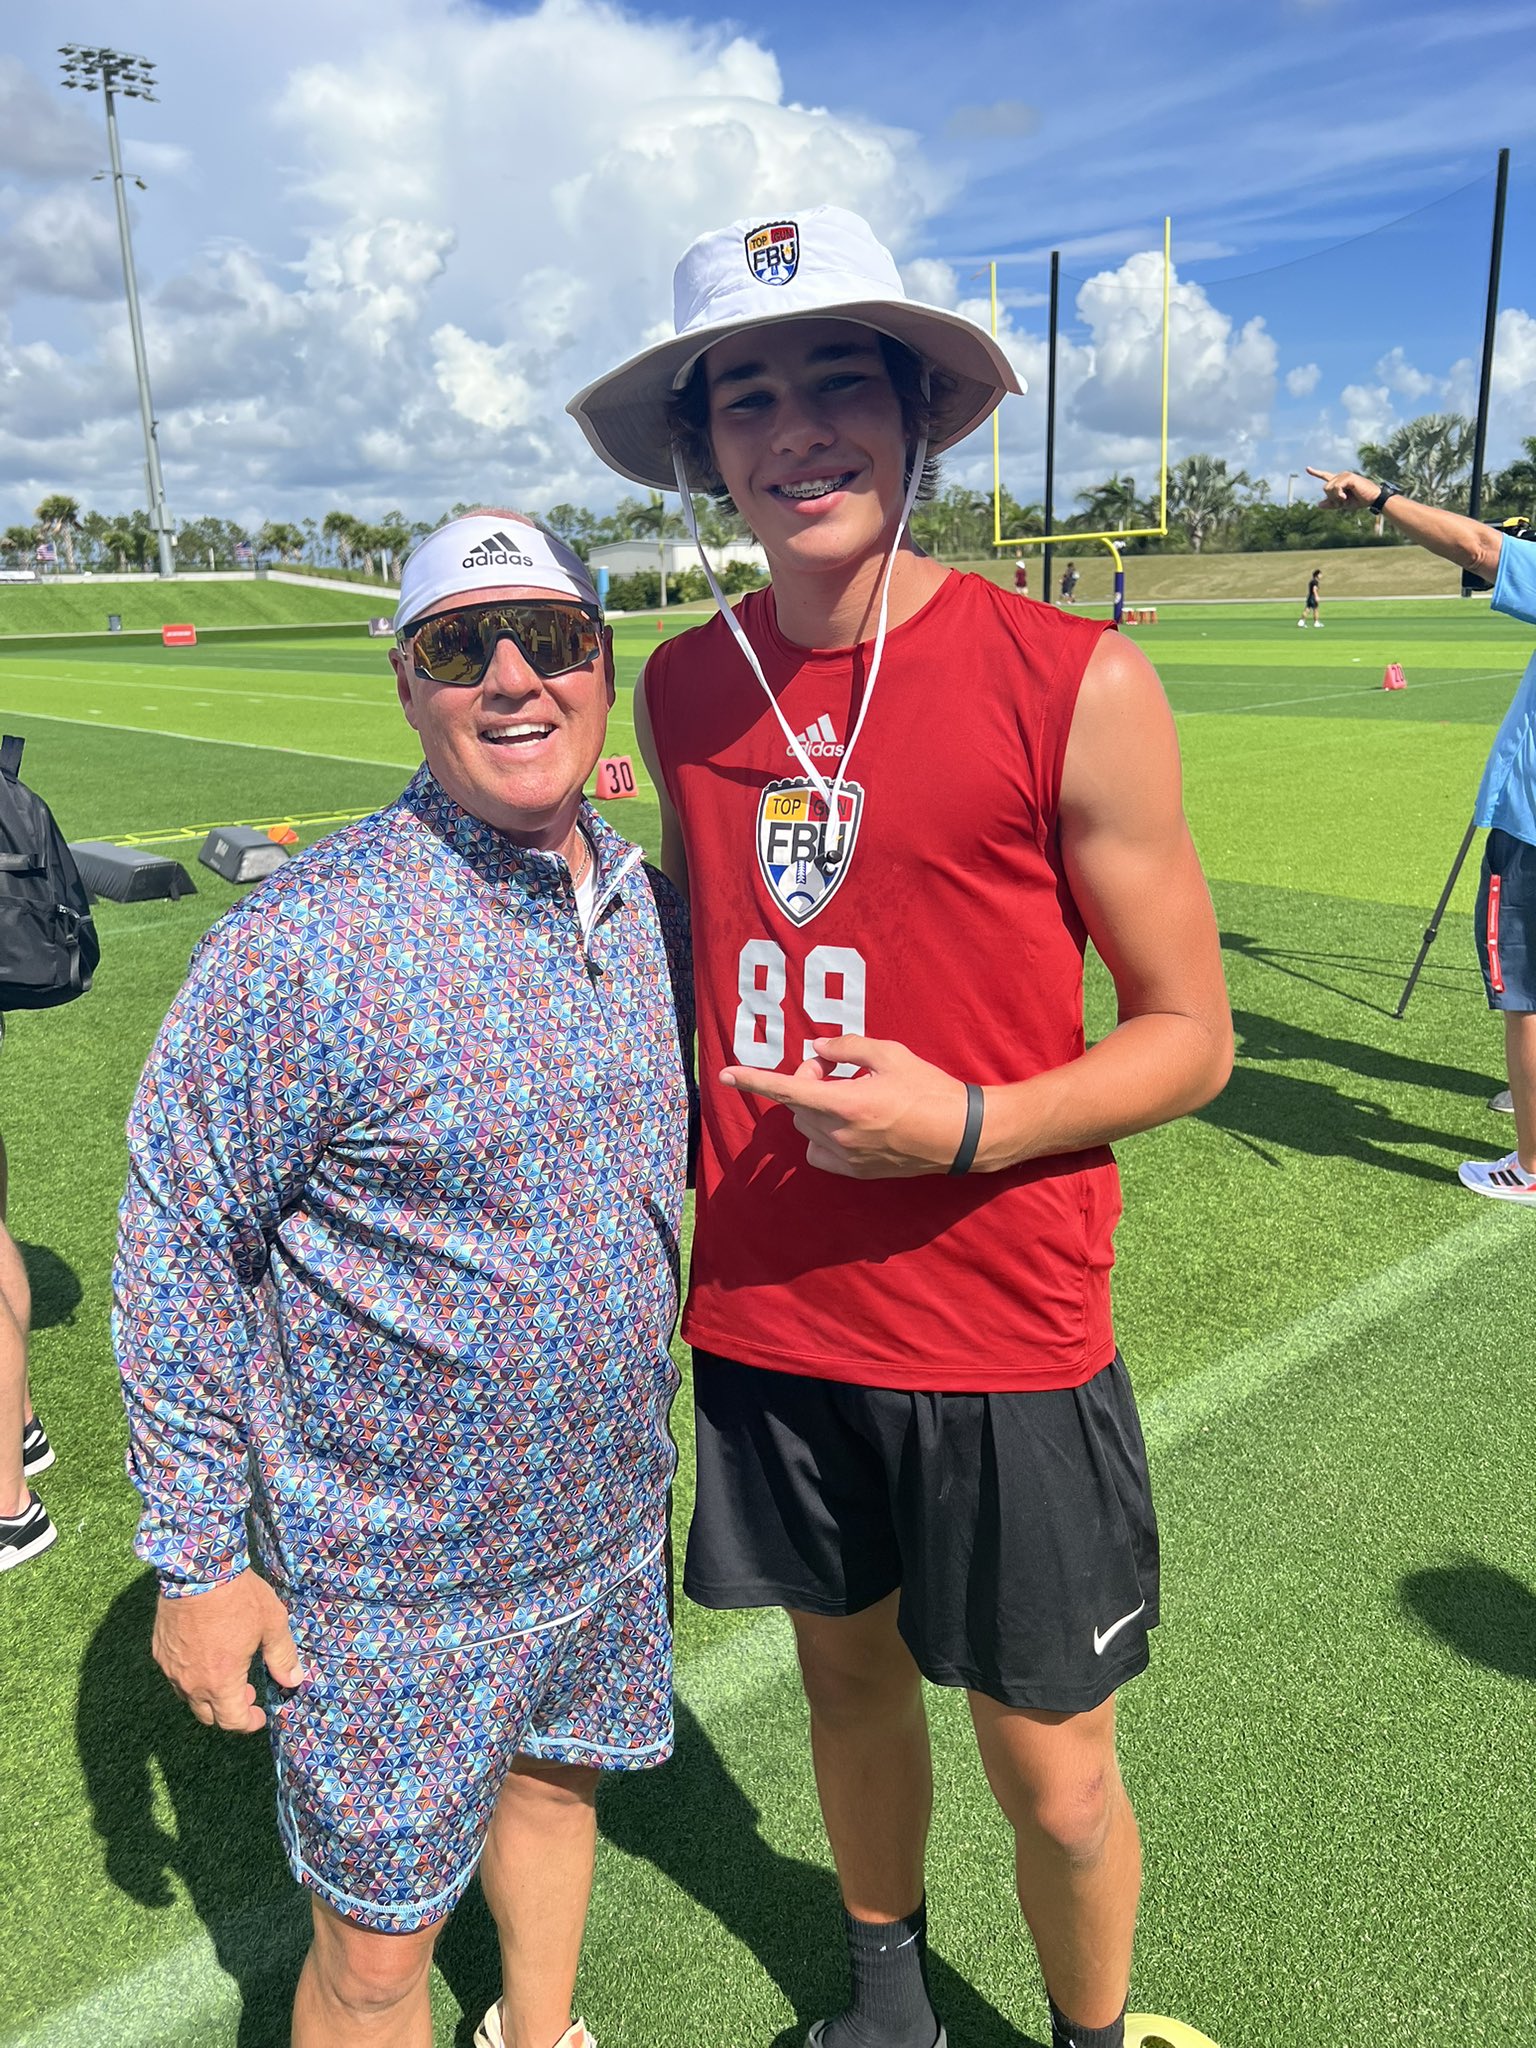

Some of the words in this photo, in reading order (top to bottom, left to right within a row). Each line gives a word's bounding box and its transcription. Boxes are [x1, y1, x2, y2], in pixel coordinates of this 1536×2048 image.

[750, 236, 768, 249] TOP
[753, 241, 796, 271] FBU
[462, 551, 533, 568] adidas
[605, 761, 634, 794] 30
[773, 798, 802, 815] TOP
[733, 938, 866, 1078] 89
